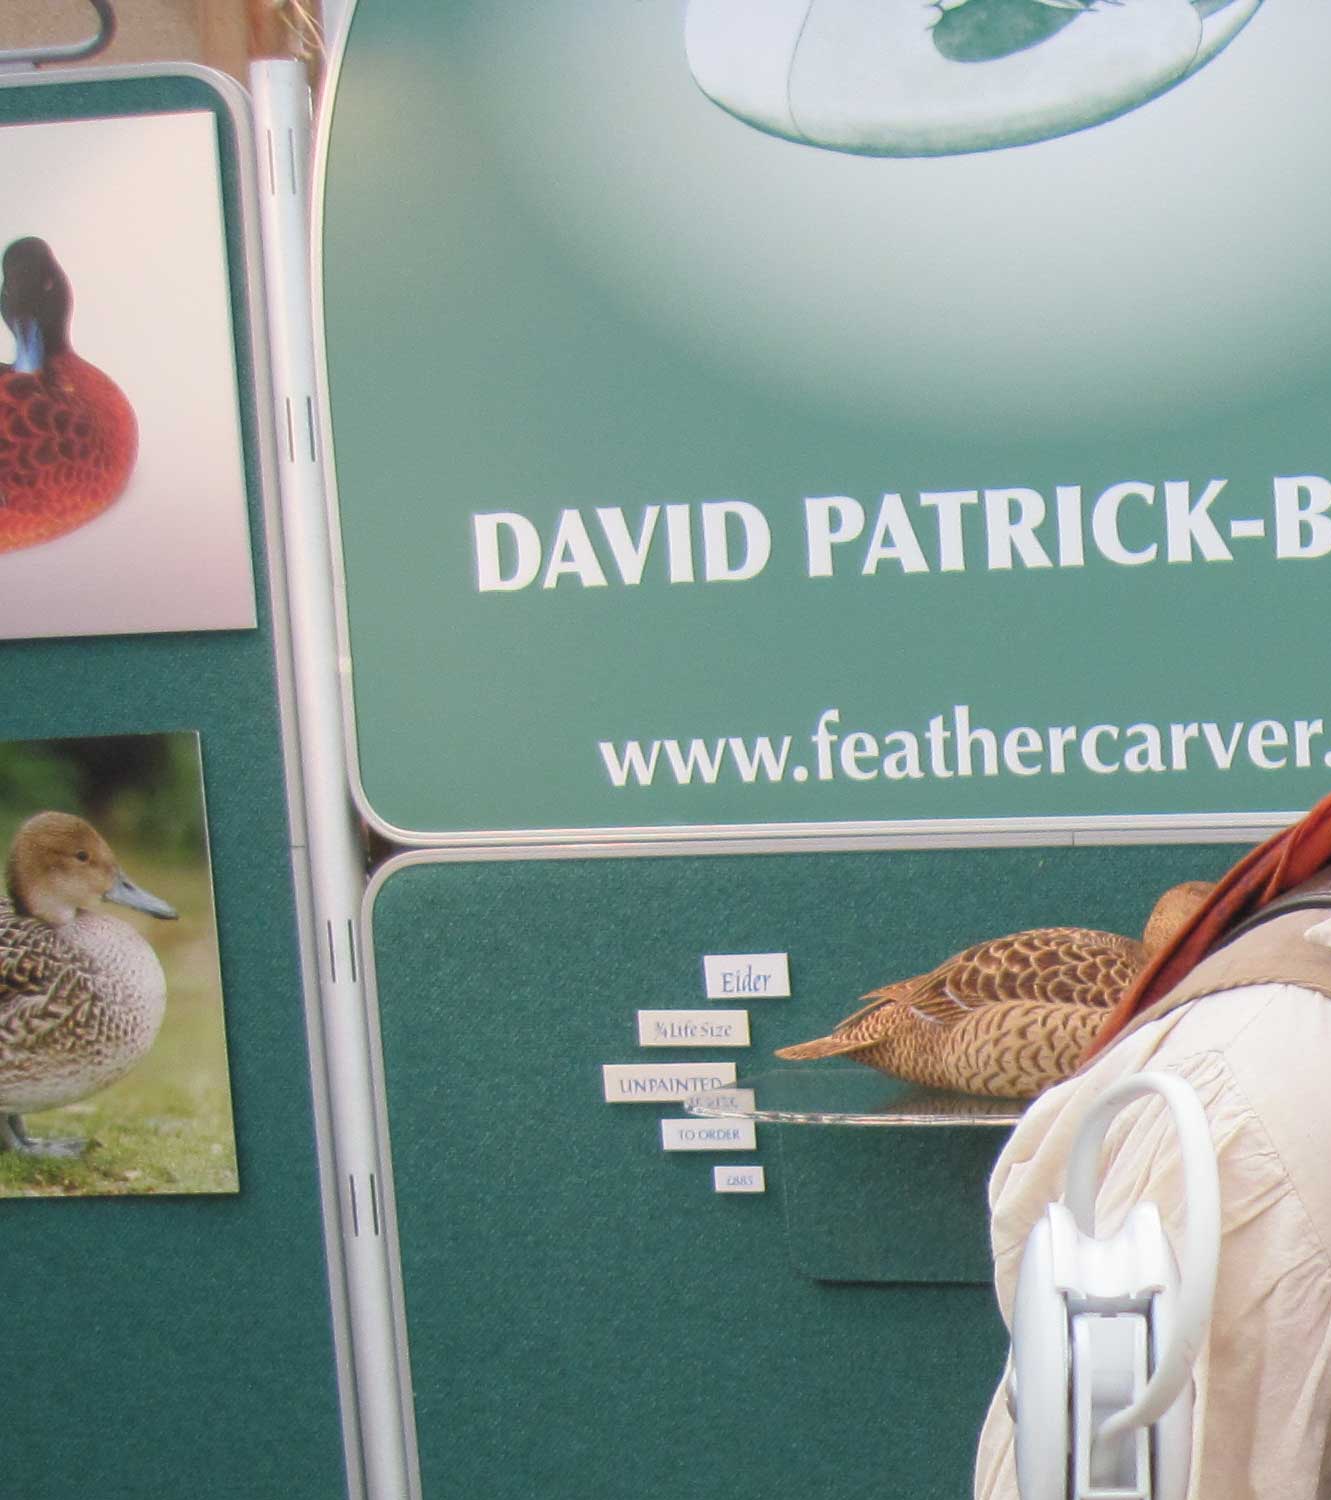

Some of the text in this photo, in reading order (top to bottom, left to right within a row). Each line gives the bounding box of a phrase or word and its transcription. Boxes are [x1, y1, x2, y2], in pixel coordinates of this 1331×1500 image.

[473, 500, 771, 593] DAVID
[721, 964, 773, 994] Eider
[669, 1019, 698, 1038] Life
[699, 1020, 734, 1039] Size
[619, 1076, 723, 1096] UNPAINTED
[678, 1127, 741, 1142] TO ORDER
